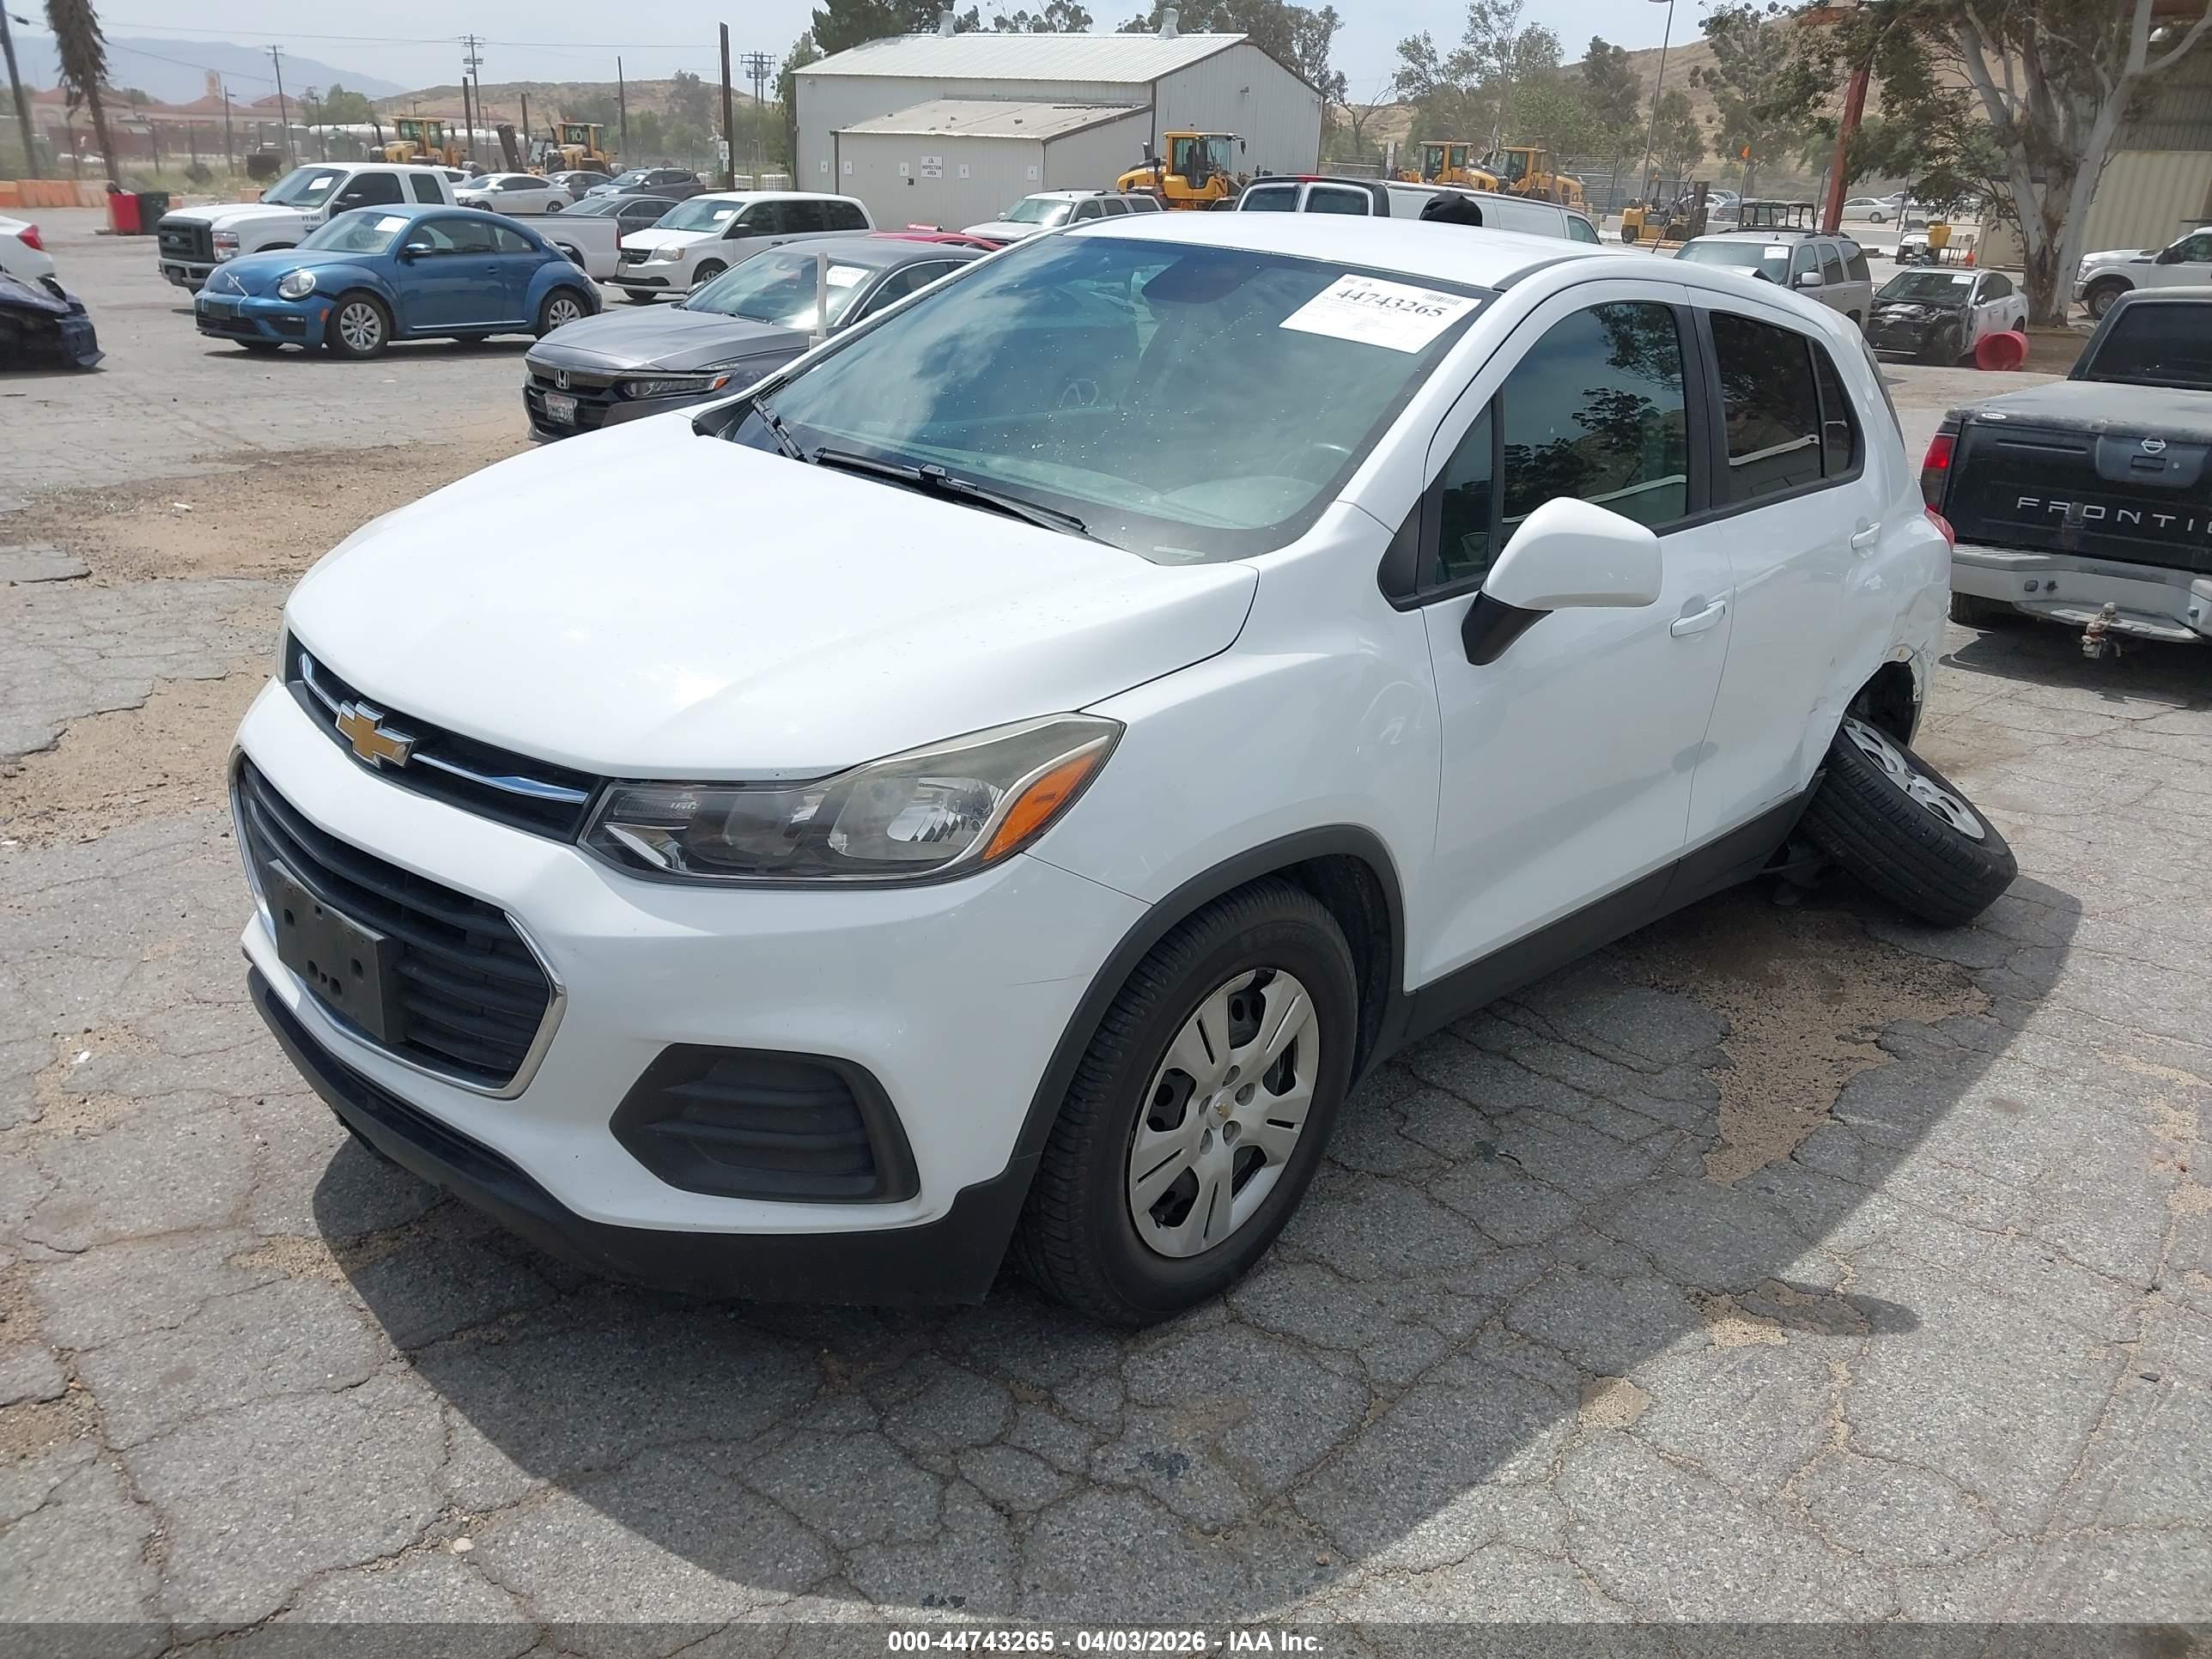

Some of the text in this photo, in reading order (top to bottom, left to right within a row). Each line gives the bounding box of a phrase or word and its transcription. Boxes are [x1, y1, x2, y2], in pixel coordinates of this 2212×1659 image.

[569, 129, 583, 143] 10
[1335, 289, 1448, 318] 44743265
[2016, 495, 2212, 534] FRONTI
